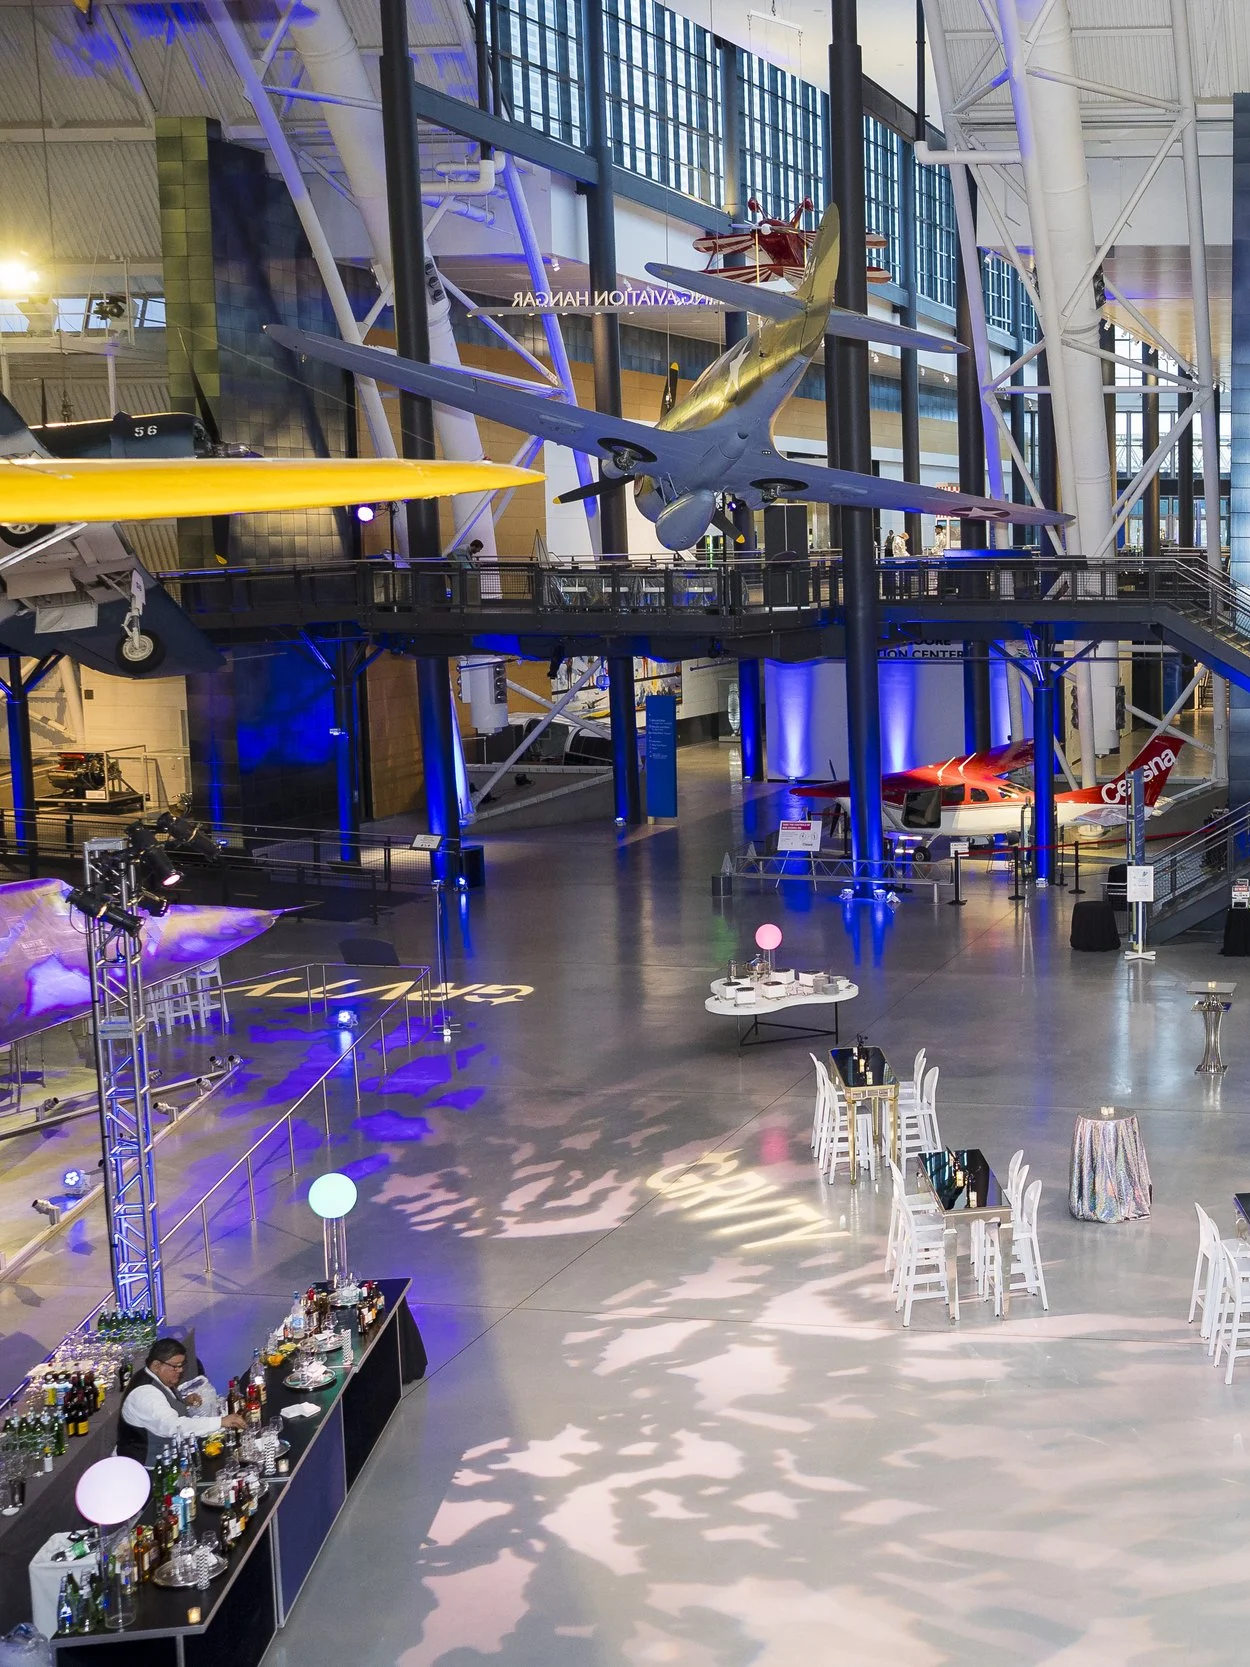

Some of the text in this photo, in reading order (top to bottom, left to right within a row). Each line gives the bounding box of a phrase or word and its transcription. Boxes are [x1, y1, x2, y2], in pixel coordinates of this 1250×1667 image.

[134, 425, 158, 437] 56
[877, 649, 908, 658] TION
[1101, 748, 1177, 804] Cesna
